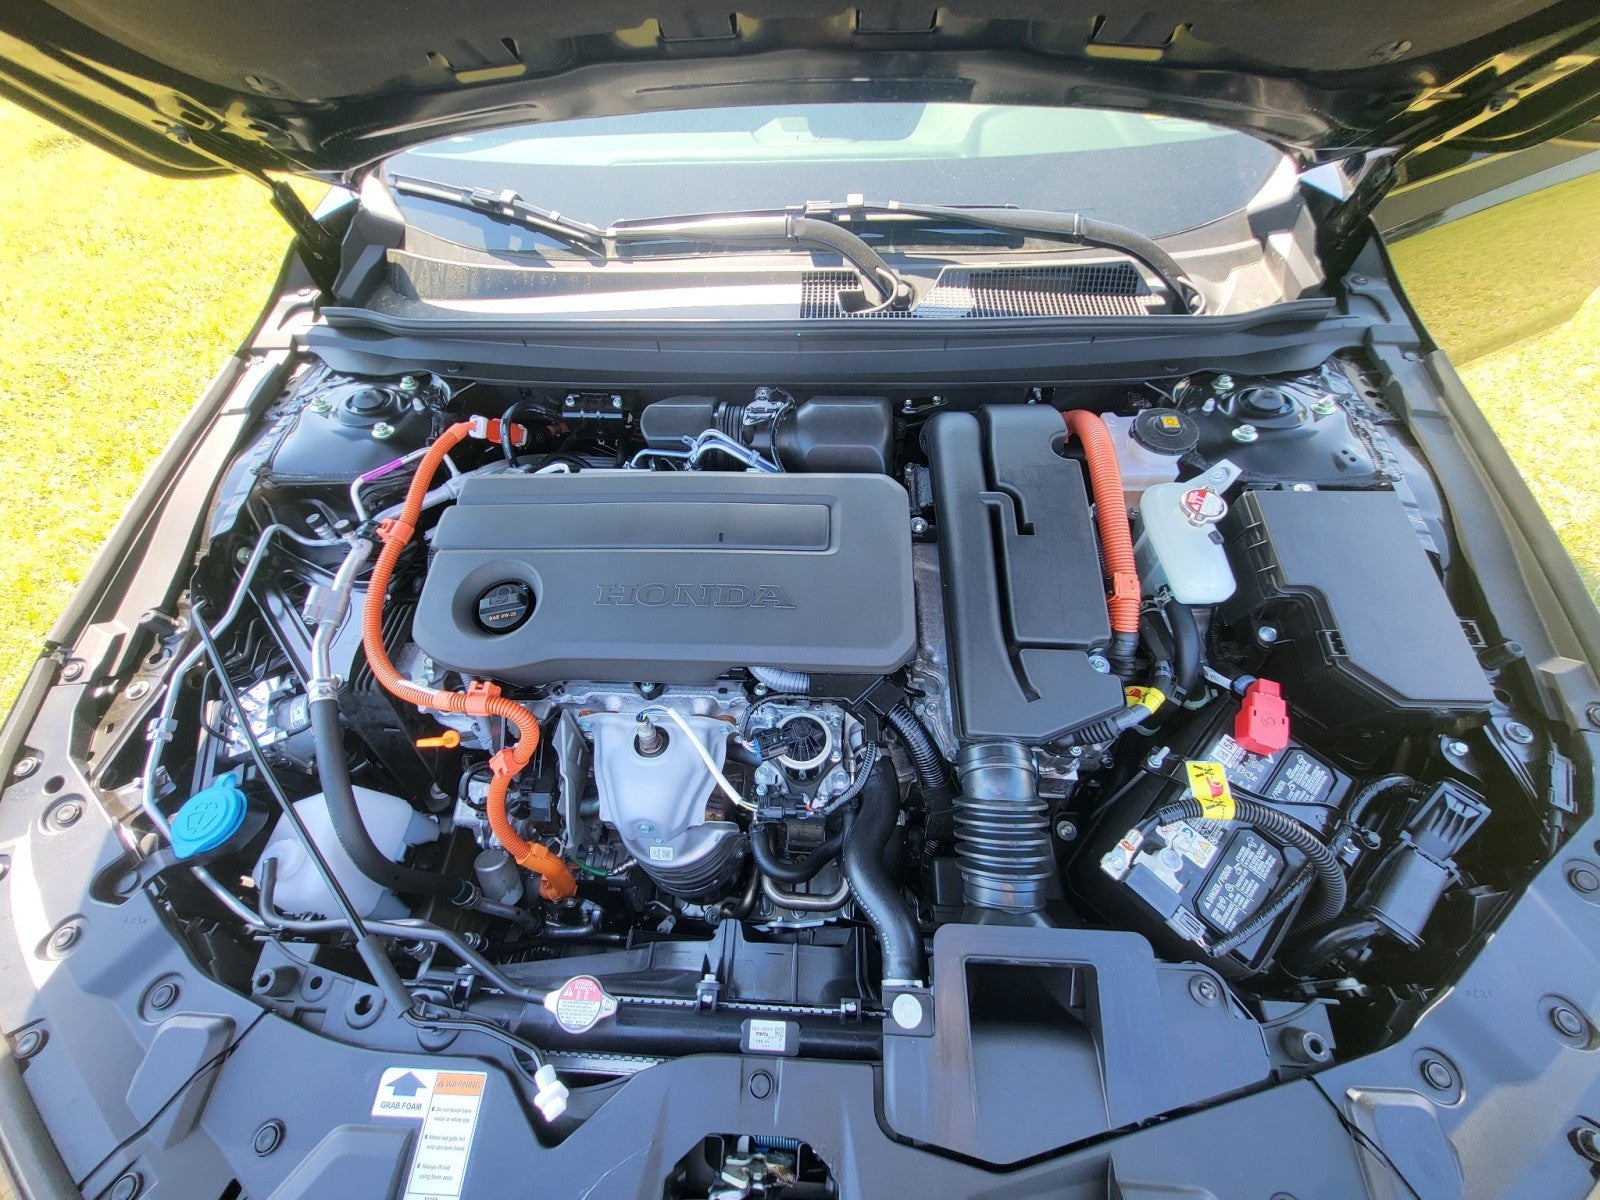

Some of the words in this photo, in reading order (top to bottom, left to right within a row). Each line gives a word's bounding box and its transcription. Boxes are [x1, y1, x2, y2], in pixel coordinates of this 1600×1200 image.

[593, 583, 796, 608] HONDA
[445, 1080, 481, 1089] WARNING
[380, 1101, 401, 1110] GRAB
[401, 1102, 422, 1111] FOAM
